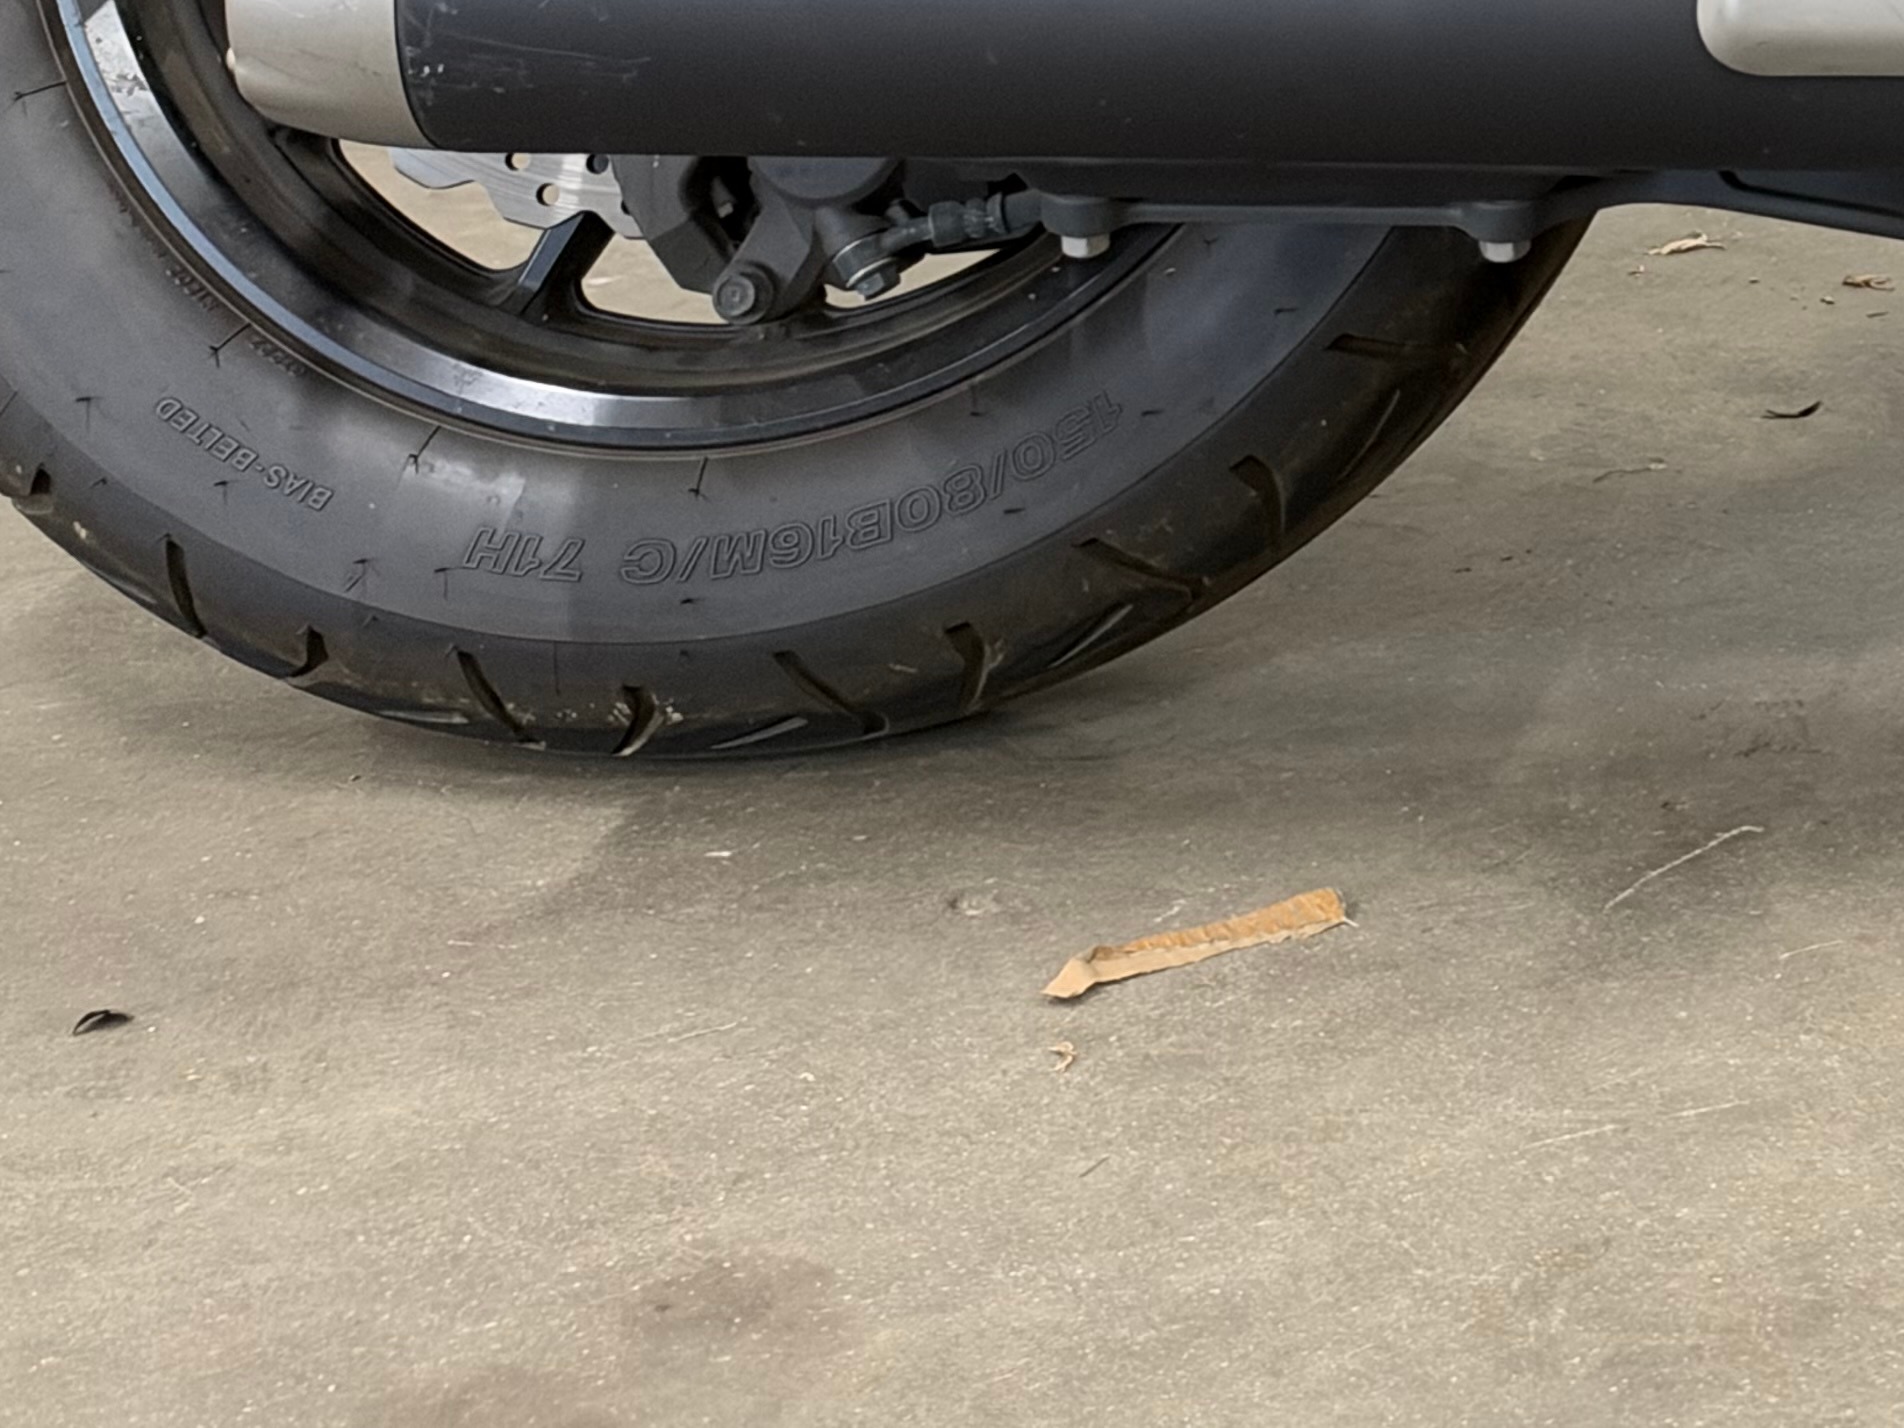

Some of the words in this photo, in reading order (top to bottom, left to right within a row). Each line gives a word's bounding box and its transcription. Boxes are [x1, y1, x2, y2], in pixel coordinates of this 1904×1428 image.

[153, 395, 333, 512] BIAS-BELTED
[620, 391, 1124, 586] 150/80B16M/C
[463, 525, 585, 584] 71H
